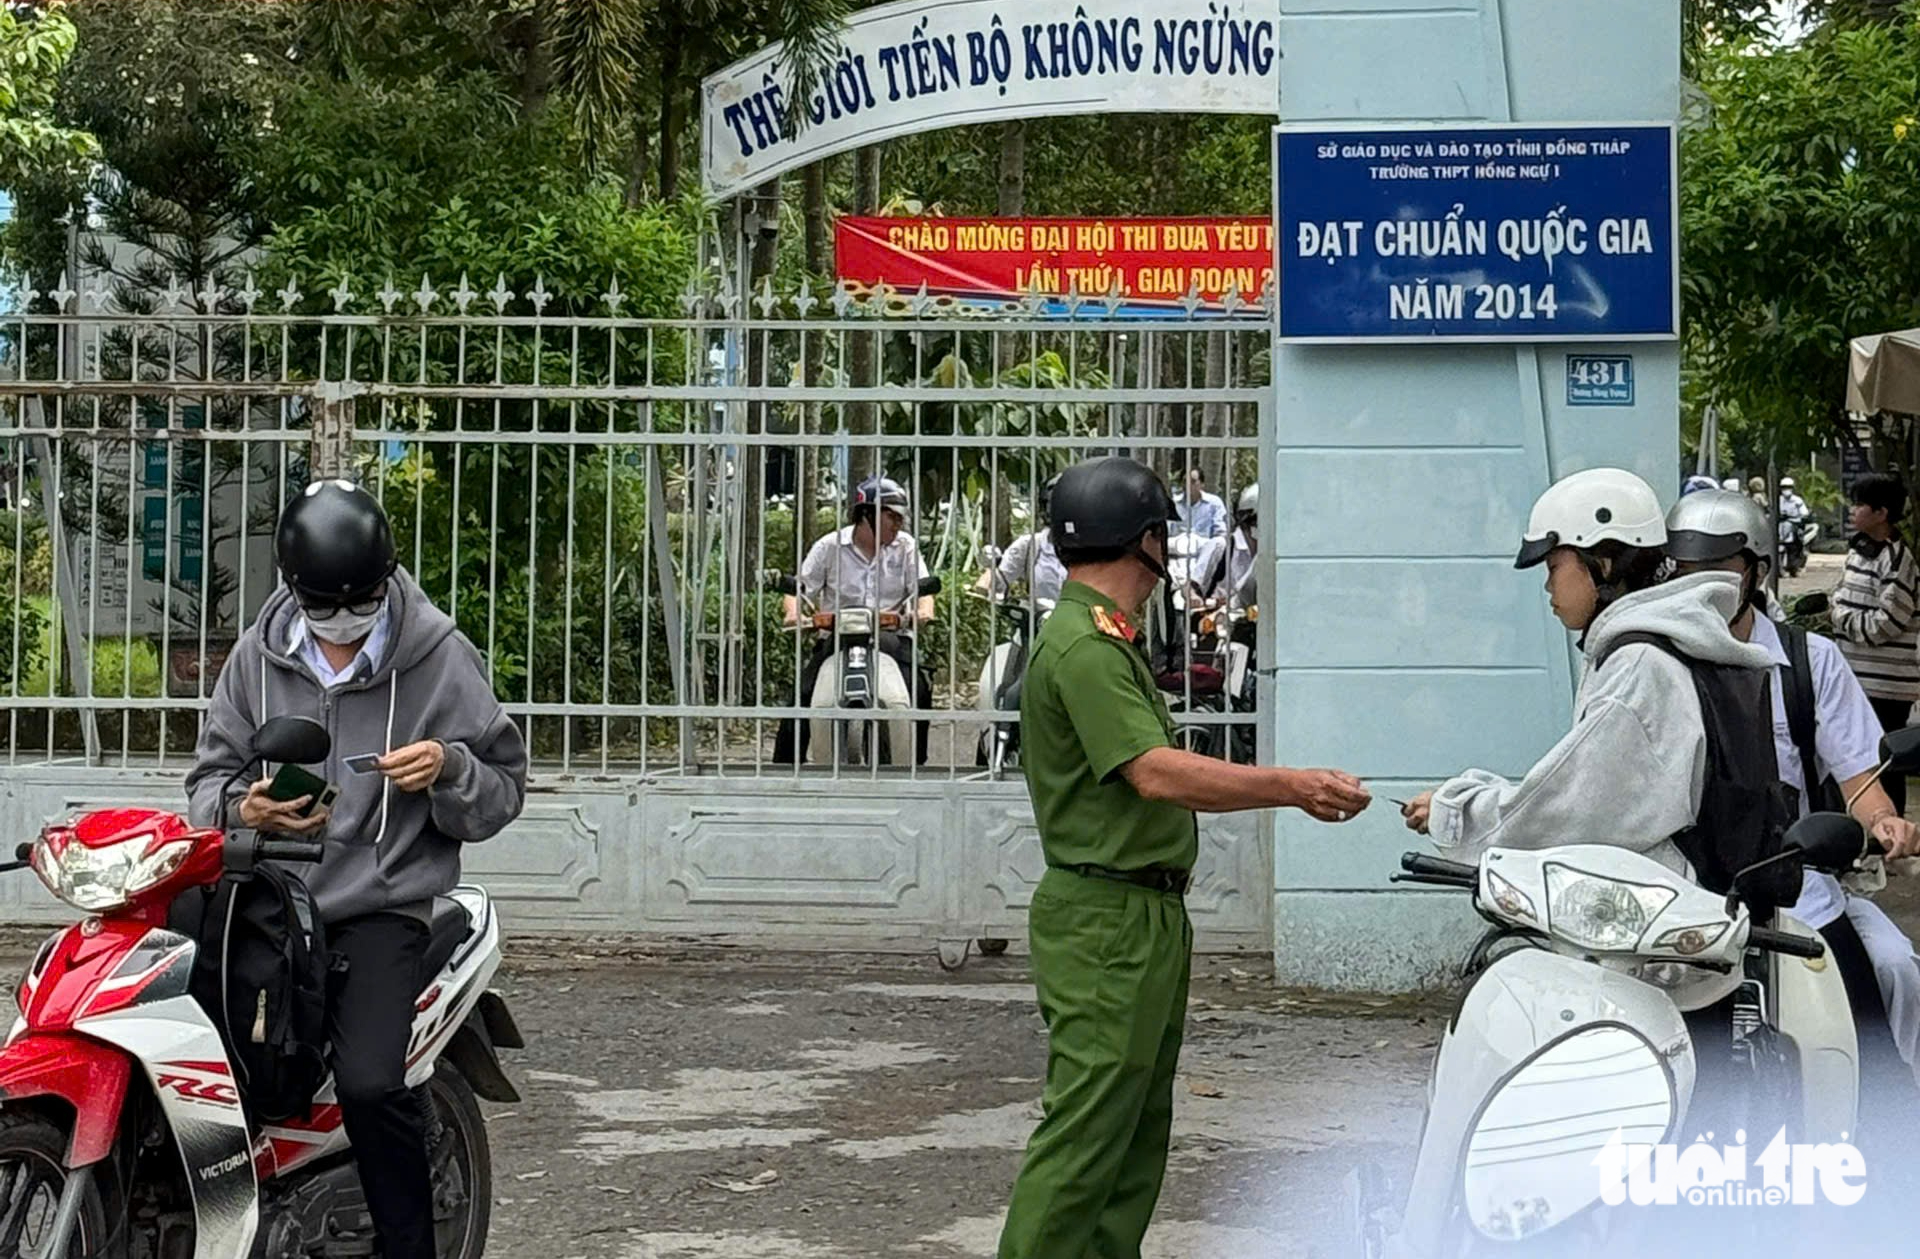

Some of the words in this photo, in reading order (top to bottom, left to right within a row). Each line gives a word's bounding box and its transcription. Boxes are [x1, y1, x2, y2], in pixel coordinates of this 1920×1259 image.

[879, 16, 960, 101] TIẾN
[966, 14, 1011, 96] BỘ
[1023, 5, 1144, 80] KHÔNG
[1153, 2, 1274, 76] NGỪNG
[1380, 144, 1411, 161] DỤC
[1415, 141, 1434, 157] VÀ
[1474, 143, 1503, 159] TẠO
[1432, 165, 1470, 179] THPT
[889, 222, 949, 251] CHÀO
[956, 221, 1024, 251] MỪNG
[1030, 225, 1069, 256] ĐẠI
[1077, 222, 1114, 256] HỘI
[1121, 225, 1156, 251] THI
[1163, 225, 1208, 251] ĐUA
[1297, 222, 1364, 265] ĐẠT
[1375, 203, 1487, 257] CHUẨN
[1498, 205, 1587, 262] QUỐC
[1598, 218, 1653, 255] GIA
[1016, 259, 1060, 293] LẦN
[1066, 262, 1112, 293] THỨ
[1138, 267, 1184, 293] GIAI
[1389, 278, 1463, 320] NĂM
[1474, 284, 1558, 320] 2014
[1570, 361, 1627, 386] 431
[199, 1150, 249, 1181] VICTORIA
